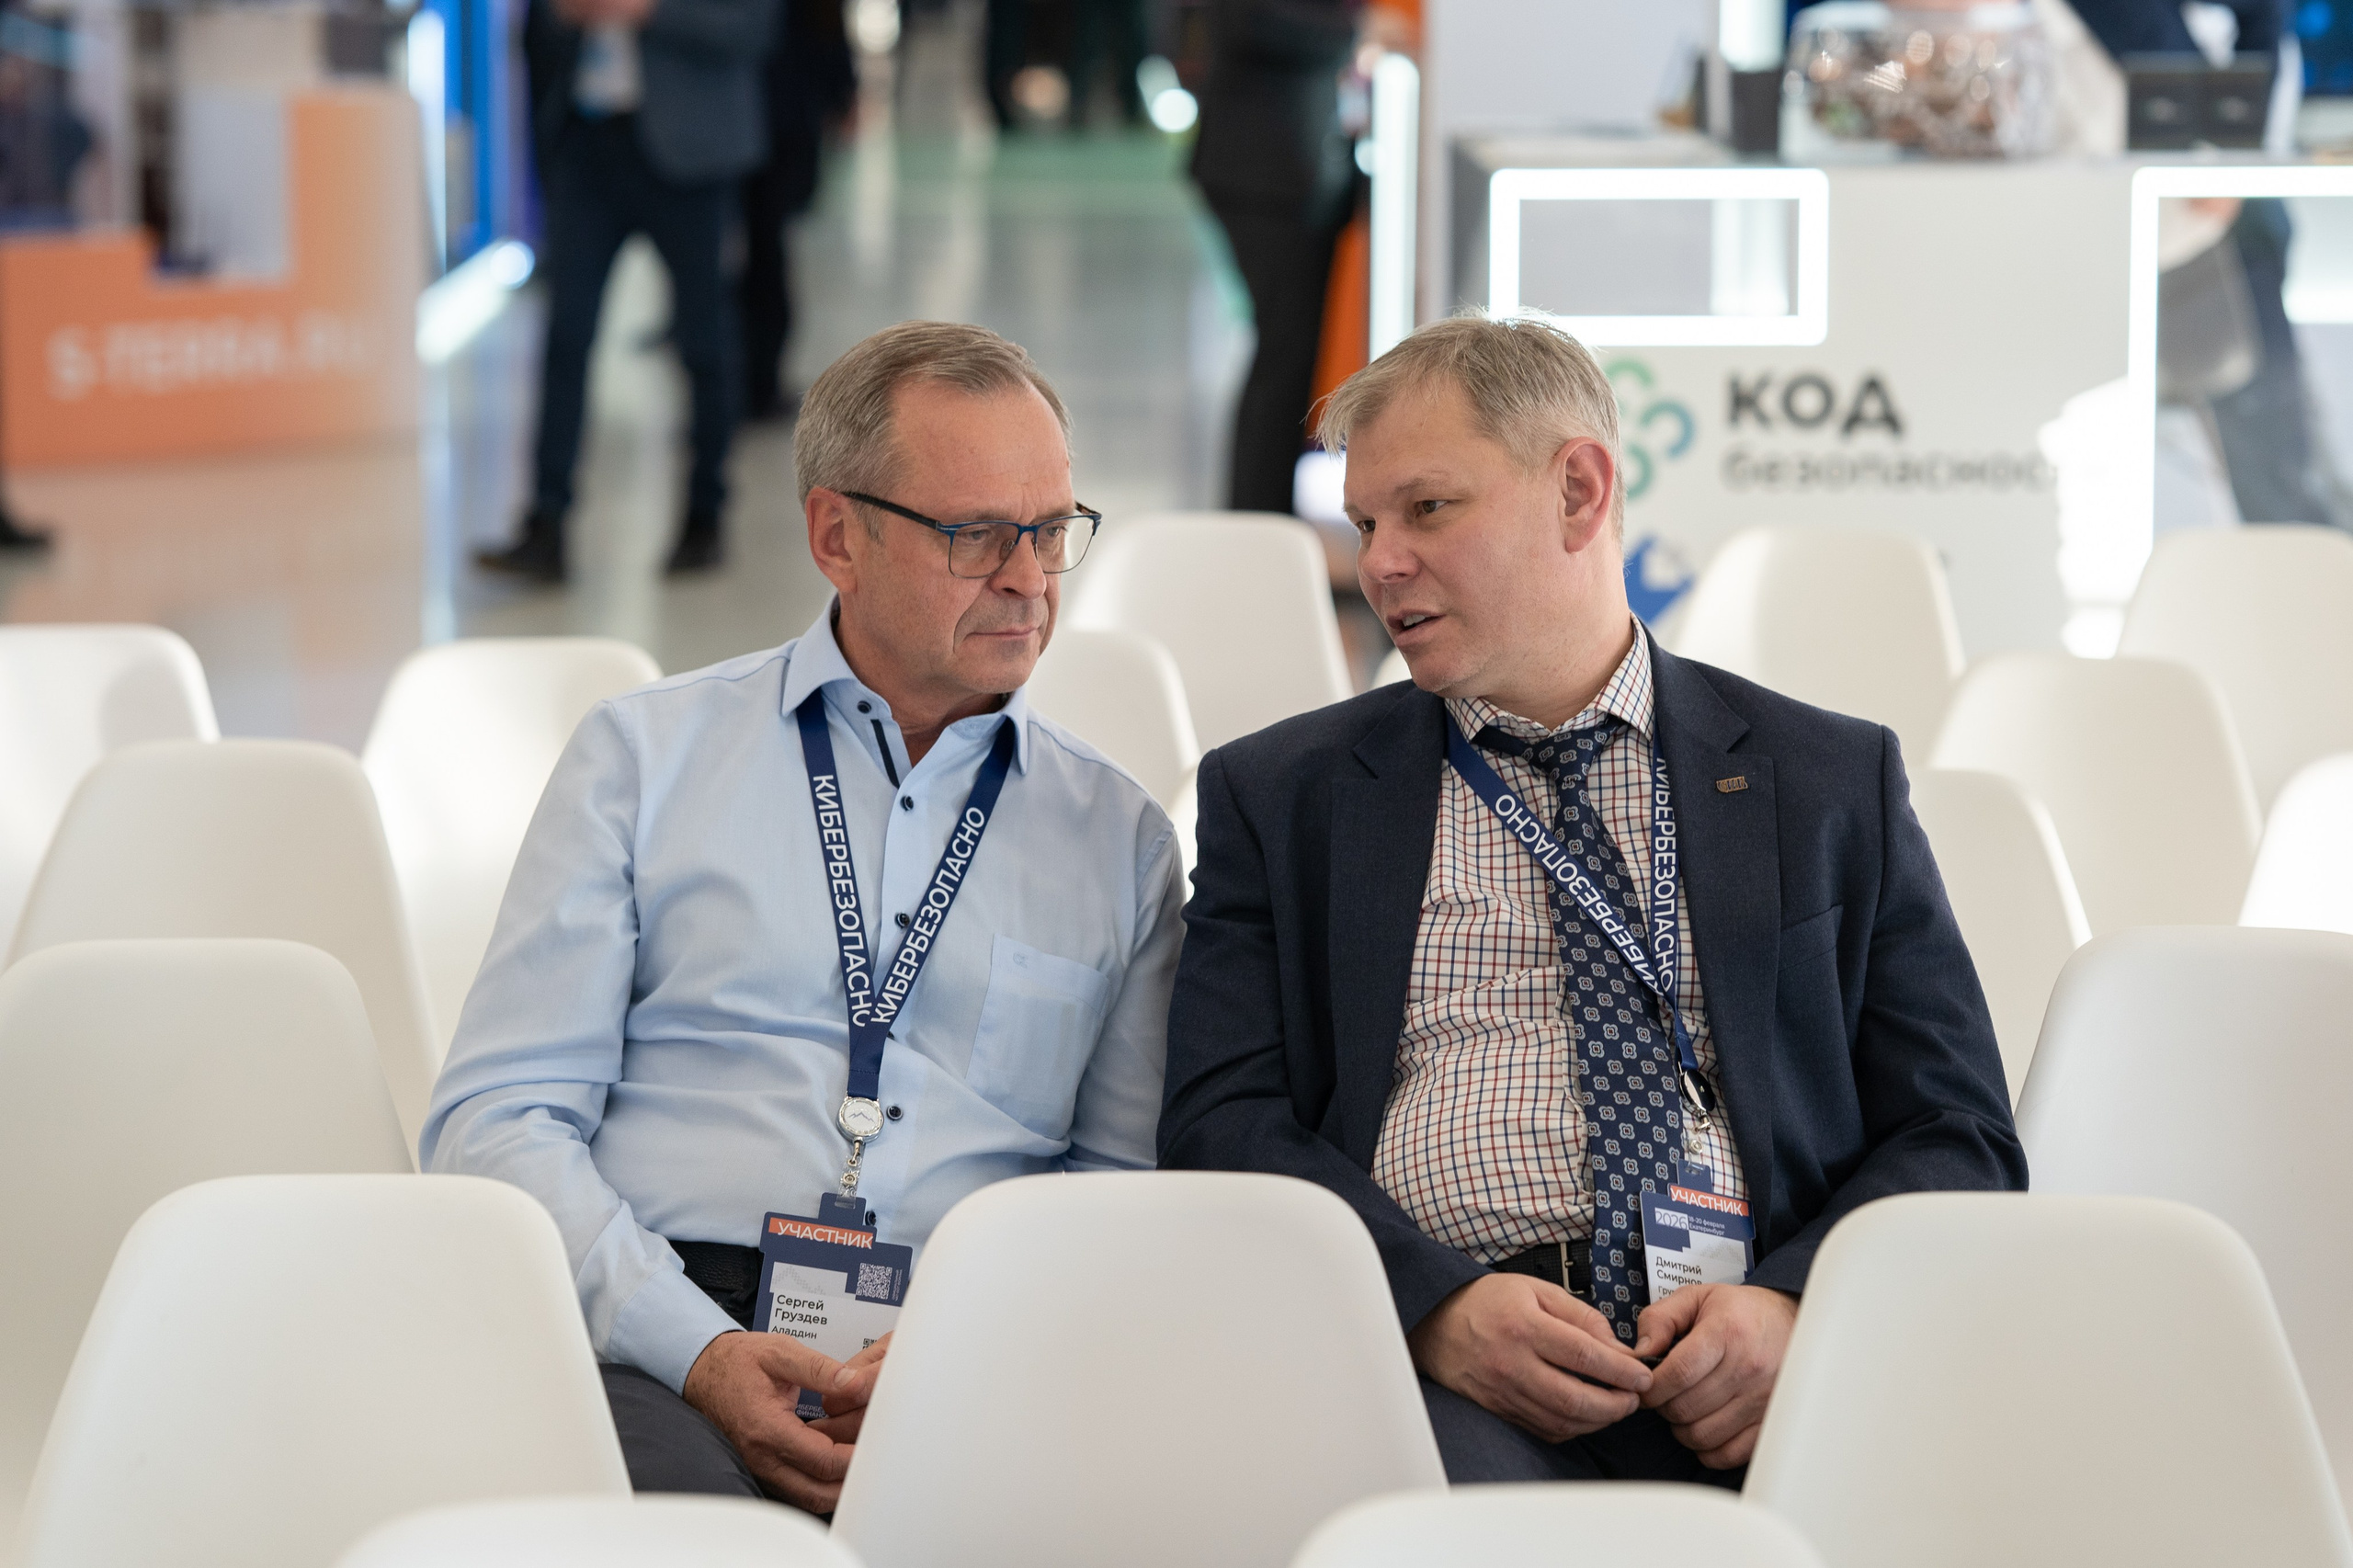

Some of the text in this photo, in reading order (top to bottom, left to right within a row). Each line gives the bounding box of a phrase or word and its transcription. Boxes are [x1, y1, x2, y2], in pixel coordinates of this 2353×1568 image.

[1727, 371, 1905, 439] КОД
[1721, 446, 2059, 493] безопаснос
[870, 806, 985, 1024] КИБЕРБЕЗОПАСНО
[1669, 1187, 1744, 1217] УЧАСТНИК
[1655, 1211, 1688, 1230] 2026
[778, 1221, 874, 1250] УЧАСТНИК
[1655, 1256, 1702, 1276] Дмитрий
[777, 1294, 824, 1311] Сергей
[775, 1308, 828, 1325] Груздев
[771, 1325, 817, 1339] Аладдин
